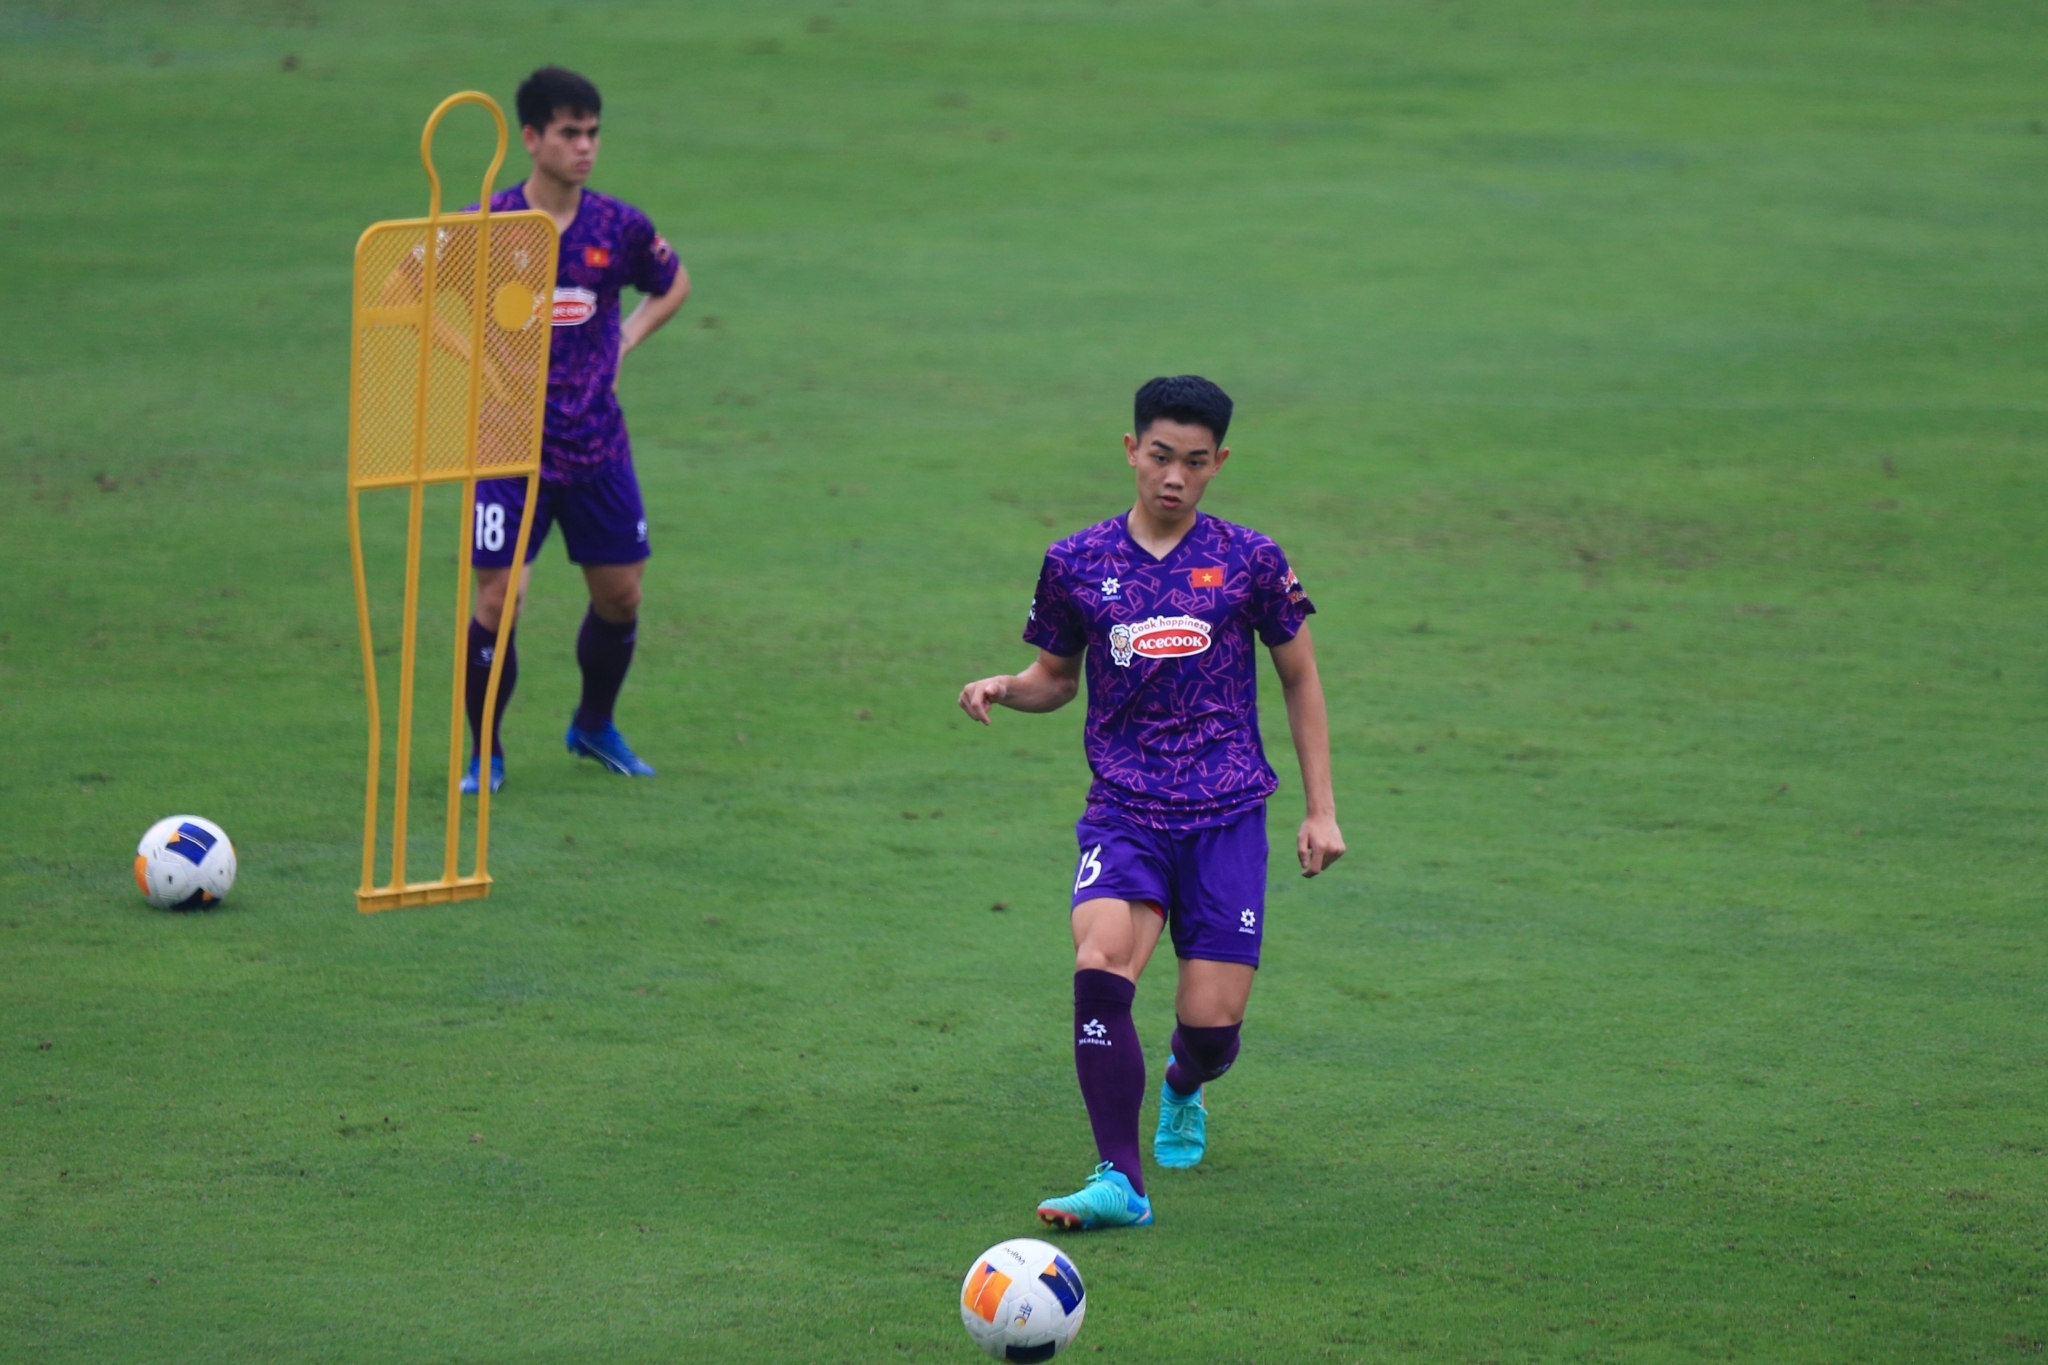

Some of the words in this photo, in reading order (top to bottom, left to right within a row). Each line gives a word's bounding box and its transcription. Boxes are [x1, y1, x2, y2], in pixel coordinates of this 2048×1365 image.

[475, 502, 506, 552] 18
[1131, 620, 1157, 634] Cook
[1159, 617, 1209, 632] happiness
[1074, 843, 1102, 895] 15
